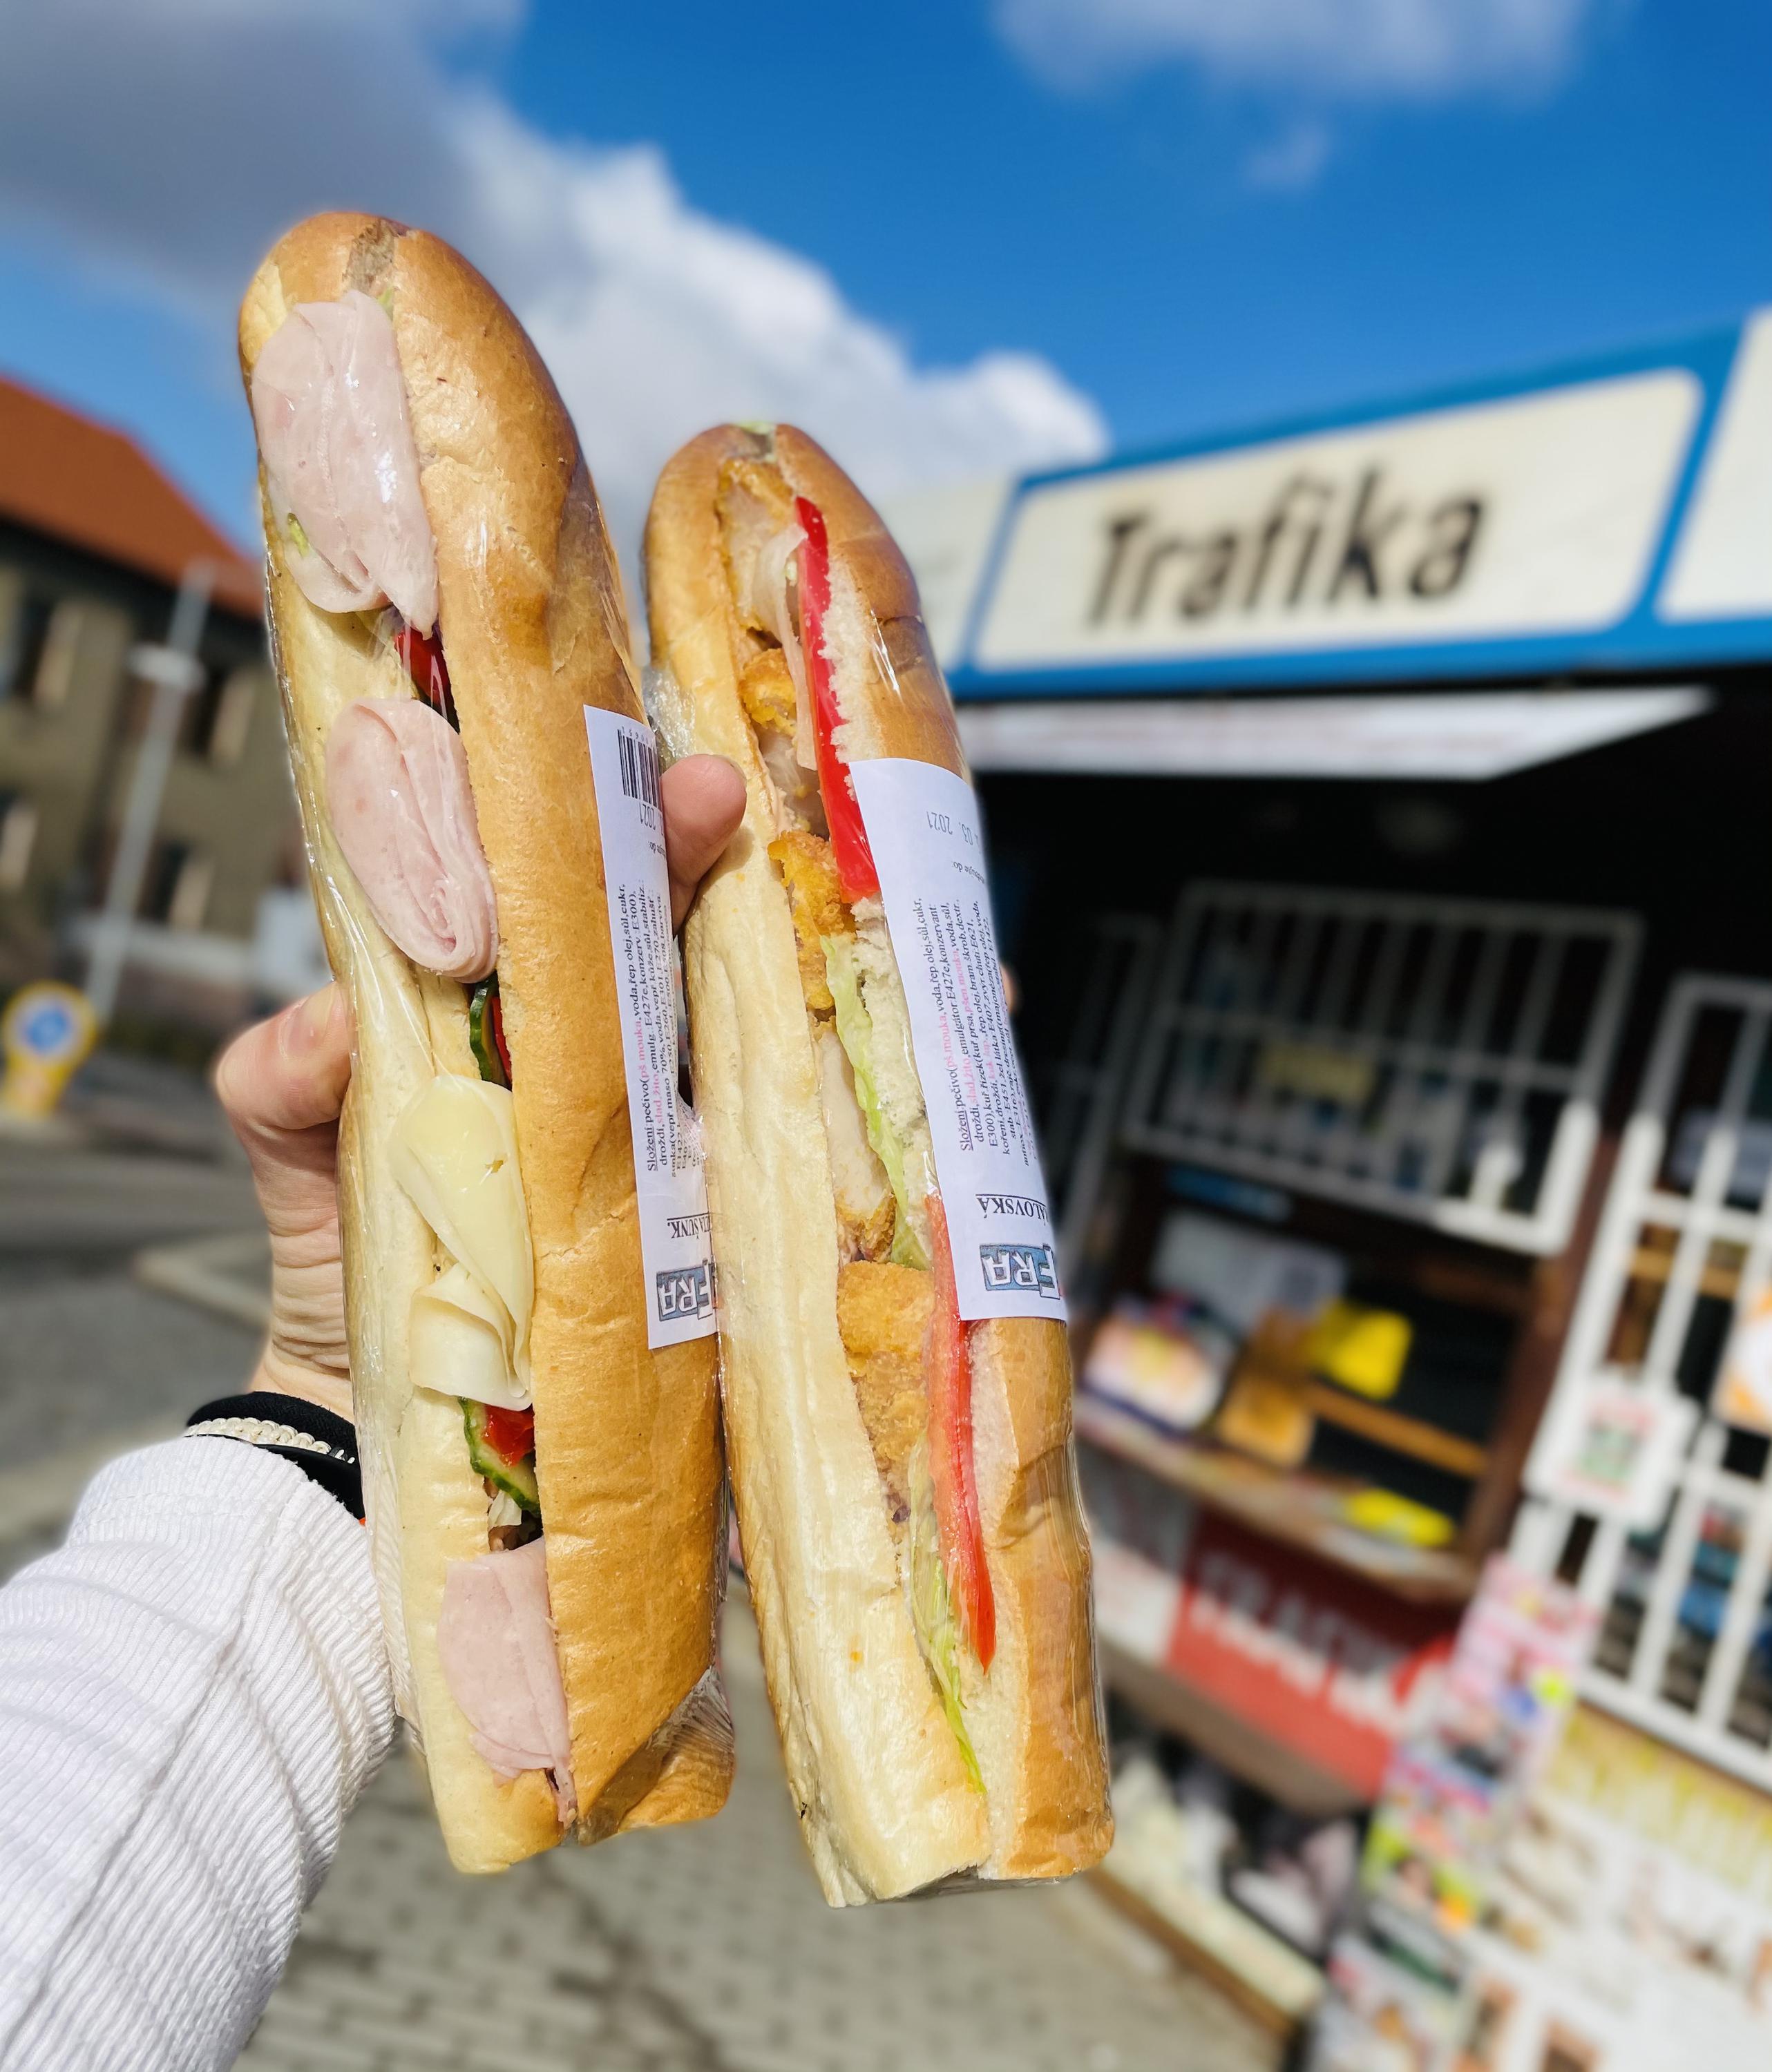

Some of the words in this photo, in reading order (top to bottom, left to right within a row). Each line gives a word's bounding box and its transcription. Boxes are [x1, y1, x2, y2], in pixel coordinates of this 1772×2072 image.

[1092, 466, 1485, 625] Trafika
[976, 1197, 1048, 1226] ÁLOVSKÁ
[658, 1260, 715, 1319] FRA
[981, 1244, 1061, 1300] FRA
